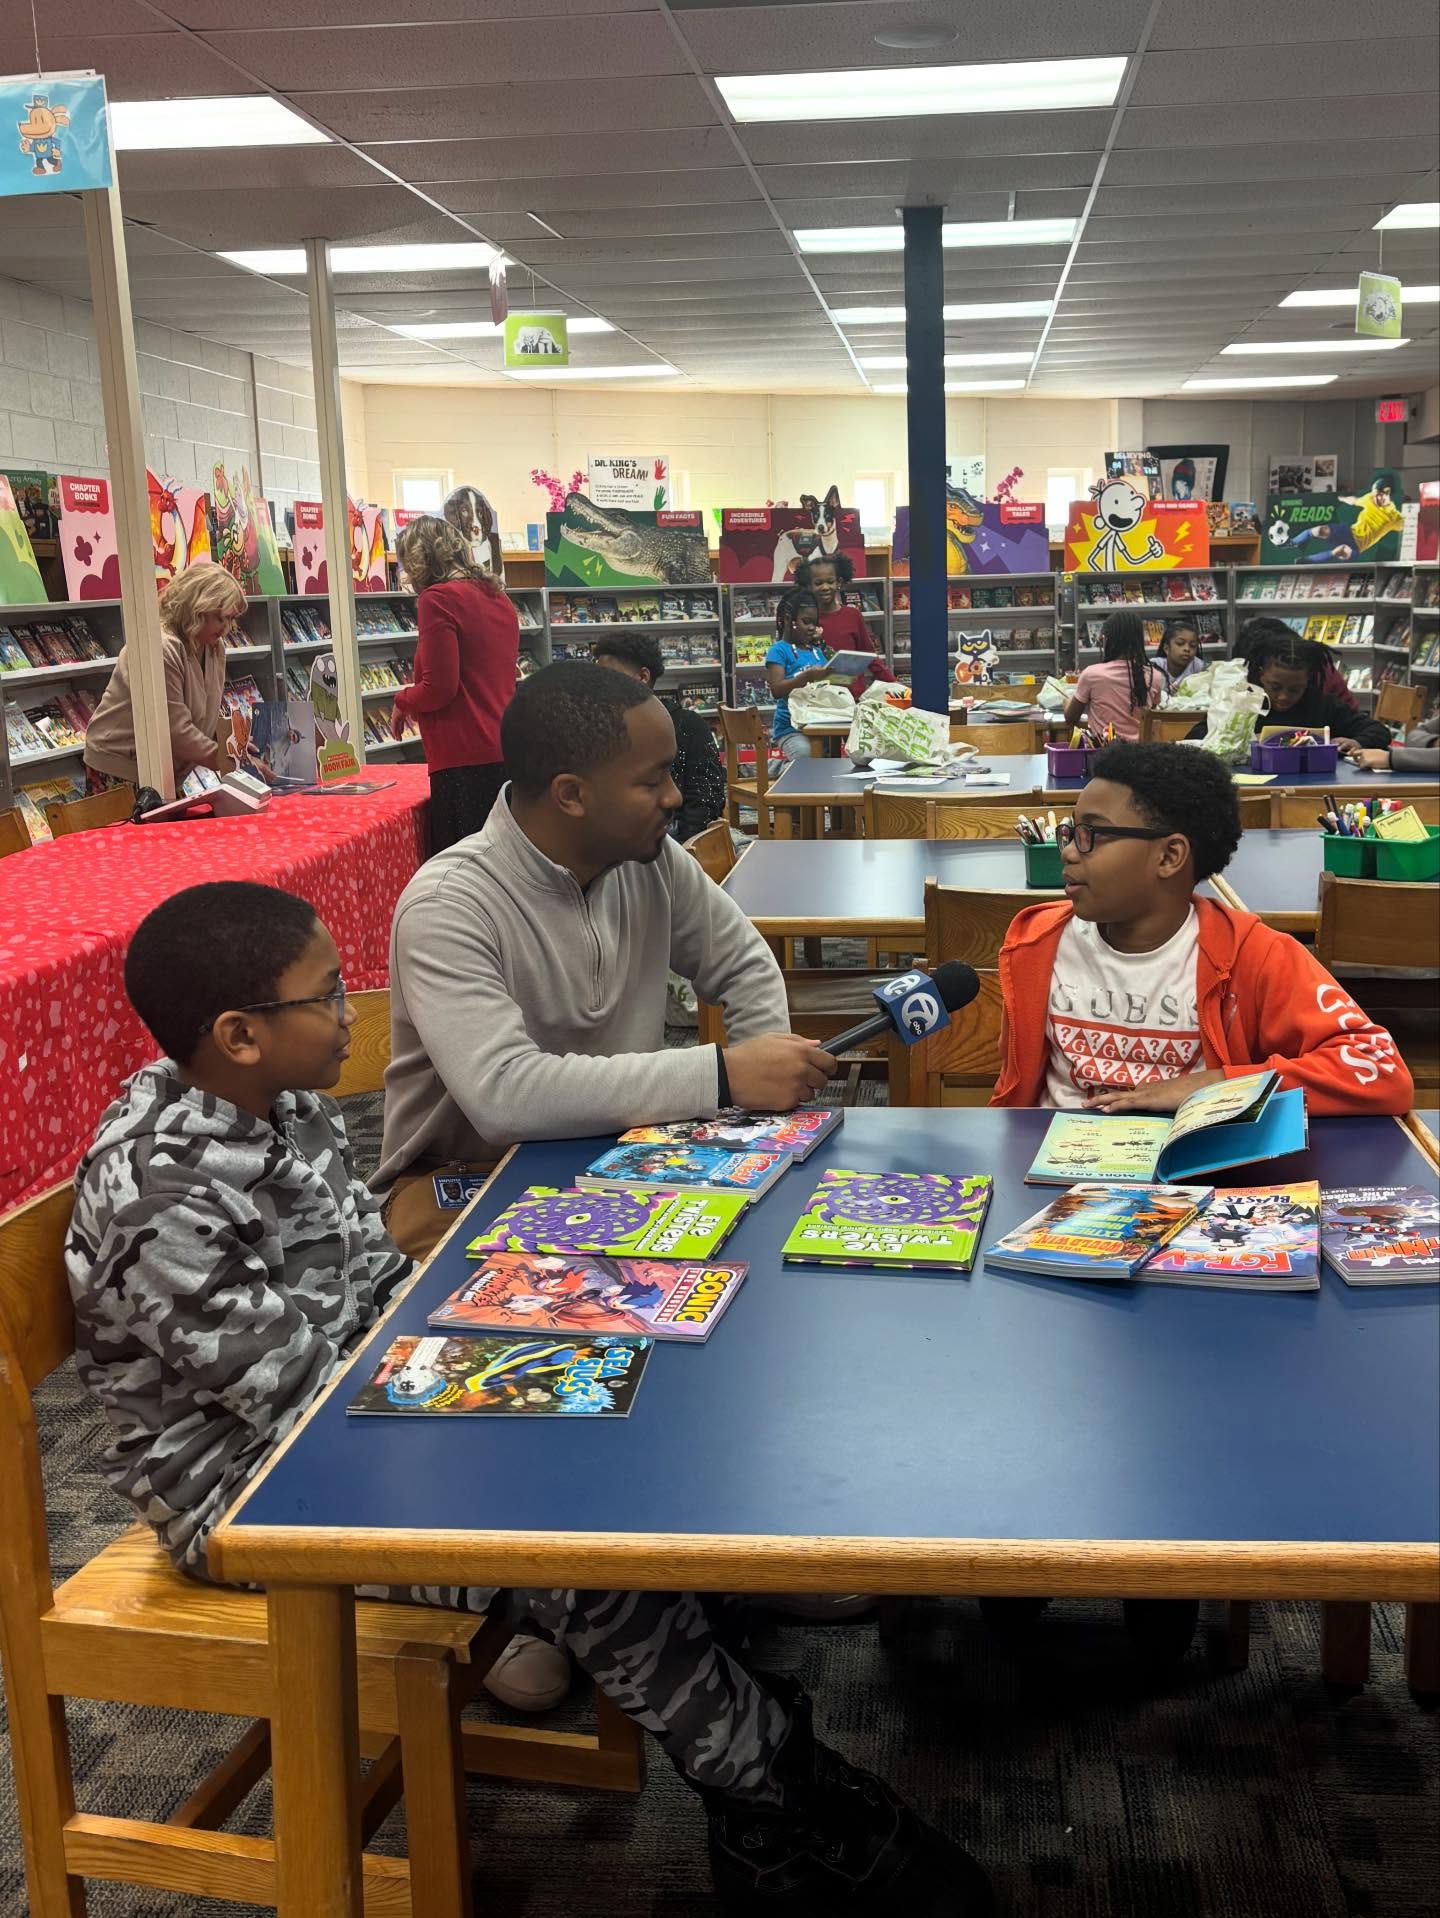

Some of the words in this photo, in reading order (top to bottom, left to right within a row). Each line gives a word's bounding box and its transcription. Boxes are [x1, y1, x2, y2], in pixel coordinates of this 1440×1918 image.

[1379, 400, 1405, 422] EXIT
[613, 468, 649, 481] DREAM!
[70, 483, 101, 493] CHAPTER
[74, 493, 98, 502] BOOKS
[1290, 505, 1335, 523] READS
[1072, 1039, 1086, 1053] G
[1103, 1044, 1116, 1058] G
[1132, 1049, 1146, 1063] G
[1163, 1051, 1177, 1064] G
[1223, 1194, 1292, 1204] BLASTS
[1069, 1238, 1124, 1254] WOULD
[683, 1269, 700, 1283] THE
[656, 1285, 690, 1322] HEDGEHOG
[672, 1270, 734, 1323] SONIC
[599, 1347, 634, 1378] SEA
[553, 1358, 603, 1399] SLUGS
